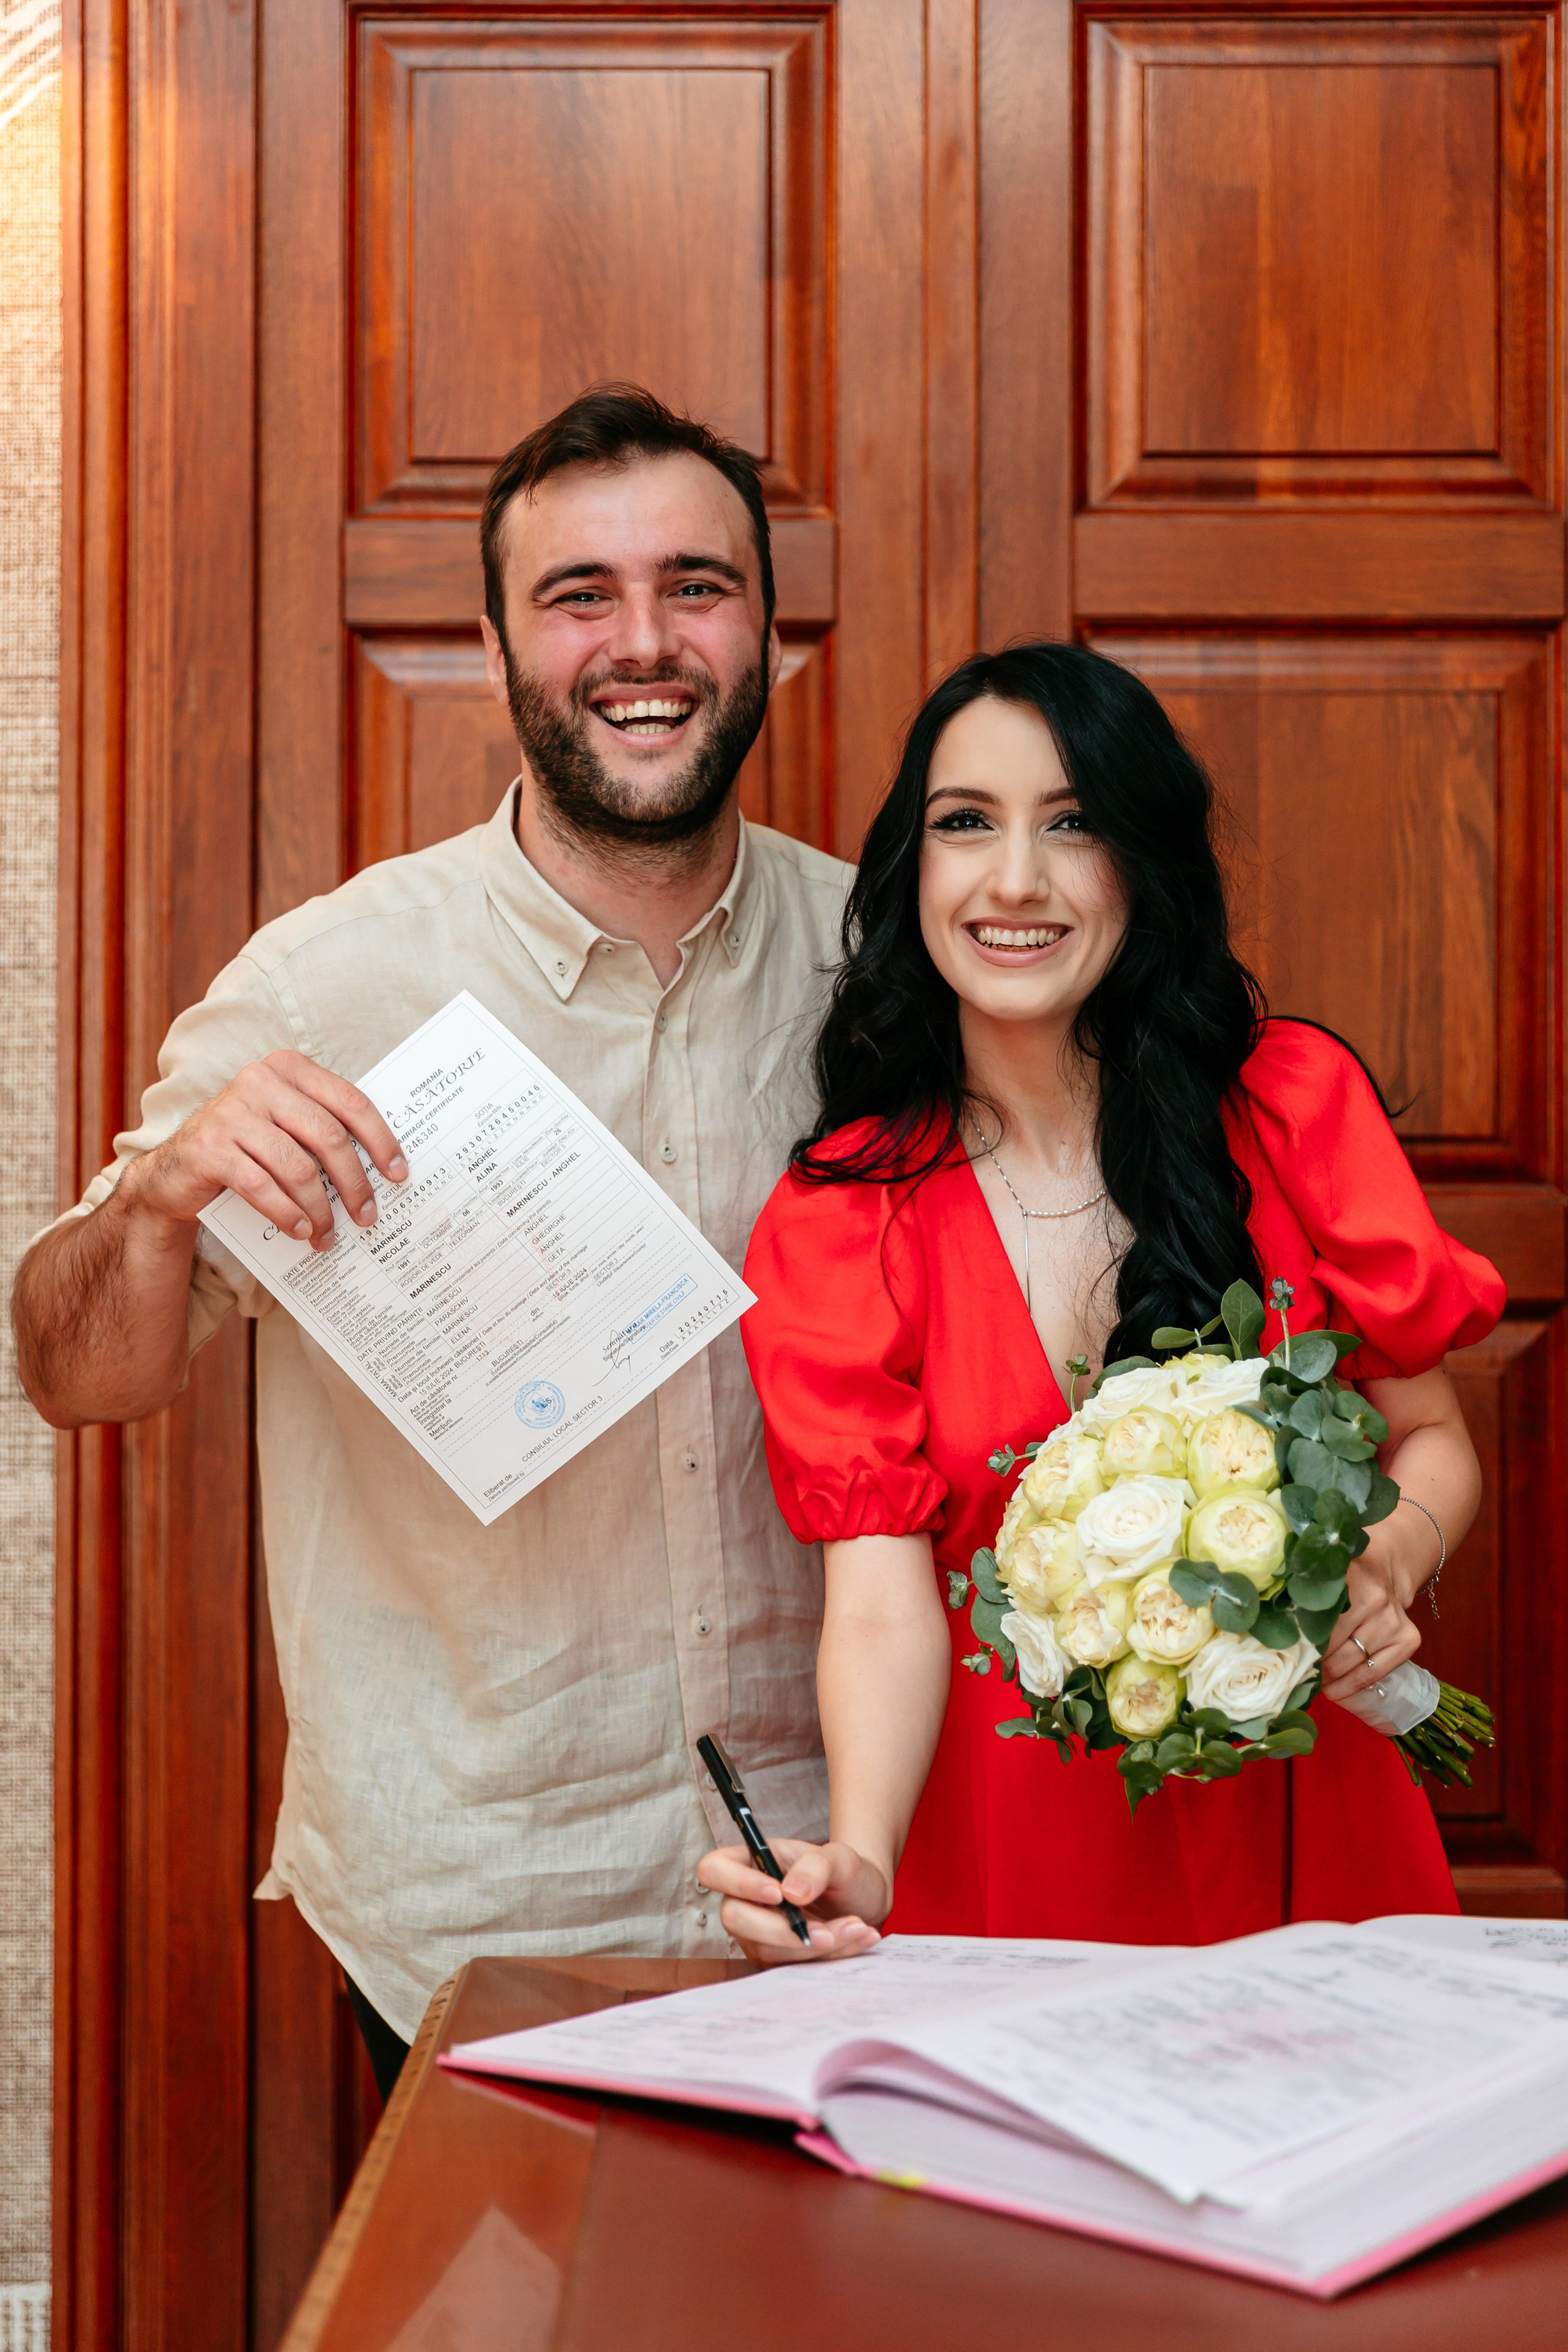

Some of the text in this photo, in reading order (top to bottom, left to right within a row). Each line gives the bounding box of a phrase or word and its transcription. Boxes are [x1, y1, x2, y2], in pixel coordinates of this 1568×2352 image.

[409, 1068, 443, 1098] ROMANIA
[395, 1085, 464, 1145] ARRIAGE CERTIFICATE
[405, 1123, 439, 1153] 246340
[545, 1127, 553, 1136] Ziua
[467, 1147, 497, 1174] ANGHEL
[511, 1154, 522, 1165] Luna
[514, 1155, 529, 1169] IULIE
[539, 1147, 562, 1167] SECTOR
[476, 1162, 498, 1183] ALINA
[478, 1184, 488, 1194] Anul
[488, 1184, 511, 1205] Localitatea
[490, 1179, 503, 1192] 1993
[506, 1178, 548, 1218] MARINESCU
[551, 1152, 581, 1178] ANGHEL
[452, 1208, 462, 1218] Ziua
[497, 1237, 508, 1247] Data
[507, 1218, 530, 1238] concerning
[535, 1199, 551, 1215] parents
[524, 1213, 549, 1236] ANGHEL
[369, 1219, 412, 1256] MARINESCU
[417, 1235, 429, 1246] Luna
[421, 1221, 453, 1249] OCTOMBRIE
[448, 1220, 480, 1248] TELEORMAN
[531, 1213, 567, 1245] GHEORGHE
[378, 1237, 410, 1264] NICOLAE
[540, 1232, 565, 1254] ANGHEL
[547, 1246, 565, 1262] GETA
[282, 1248, 320, 1281] DATE PRIVIN
[290, 1279, 301, 1289] Data
[300, 1261, 323, 1281] concerning
[329, 1244, 342, 1257] couple
[298, 1243, 356, 1292] Cod Numeric Personal
[385, 1263, 395, 1273] Anul
[397, 1259, 410, 1270] 1991
[420, 1262, 430, 1272] DE
[428, 1251, 443, 1264] VEDE
[528, 1286, 540, 1297] Data
[539, 1278, 548, 1288] and
[546, 1270, 559, 1282] place
[570, 1245, 588, 1262] marriage
[592, 1261, 615, 1281] SECTOR
[309, 1286, 331, 1305] Numele
[338, 1265, 356, 1281] familie
[394, 1264, 418, 1284] Localitatea
[409, 1262, 451, 1299] MARINESCU
[433, 1283, 453, 1300] Données
[451, 1265, 474, 1286] concernant
[480, 1248, 496, 1263] parents
[545, 1272, 567, 1291] SECTOR
[559, 1278, 575, 1292] IULIE
[573, 1267, 587, 1281] 2024
[579, 1272, 589, 1283] anul
[318, 1289, 347, 1314] Prenumele
[426, 1286, 462, 1317] MARINESCU
[641, 1278, 689, 1319] MIRELA-FRANCISCA
[660, 1302, 674, 1315] STARE
[326, 1310, 341, 1322] Data
[345, 1325, 368, 1343] Numele
[374, 1304, 393, 1320] familie
[434, 1296, 469, 1327] PARASCHIV
[442, 1304, 478, 1335] MARINESCU
[530, 1307, 540, 1316] din
[336, 1318, 352, 1333] Locul
[378, 1338, 399, 1355] Numele
[406, 1317, 425, 1332] familie
[450, 1326, 472, 1344] ELENA
[356, 1346, 374, 1362] DATE
[372, 1327, 398, 1349] PRIVIND
[386, 1340, 415, 1365] Prenumele
[394, 1355, 415, 1373] Numele
[422, 1335, 440, 1350] familie
[475, 1349, 489, 1362] 1713
[658, 1340, 674, 1353] Data
[397, 1390, 412, 1403] Data
[415, 1374, 431, 1388] locul
[428, 1355, 454, 1378] încheierii
[402, 1358, 431, 1382] Prenumele
[425, 1377, 441, 1390] IULIE
[439, 1366, 454, 1379] 2024
[380, 1378, 398, 1397] MAMA
[410, 1404, 420, 1415] Act
[521, 1436, 554, 1462] CONSILIUL
[552, 1420, 573, 1438] LOCAL
[571, 1398, 598, 1422] SECTOR
[483, 1479, 505, 1498] Eliberat
